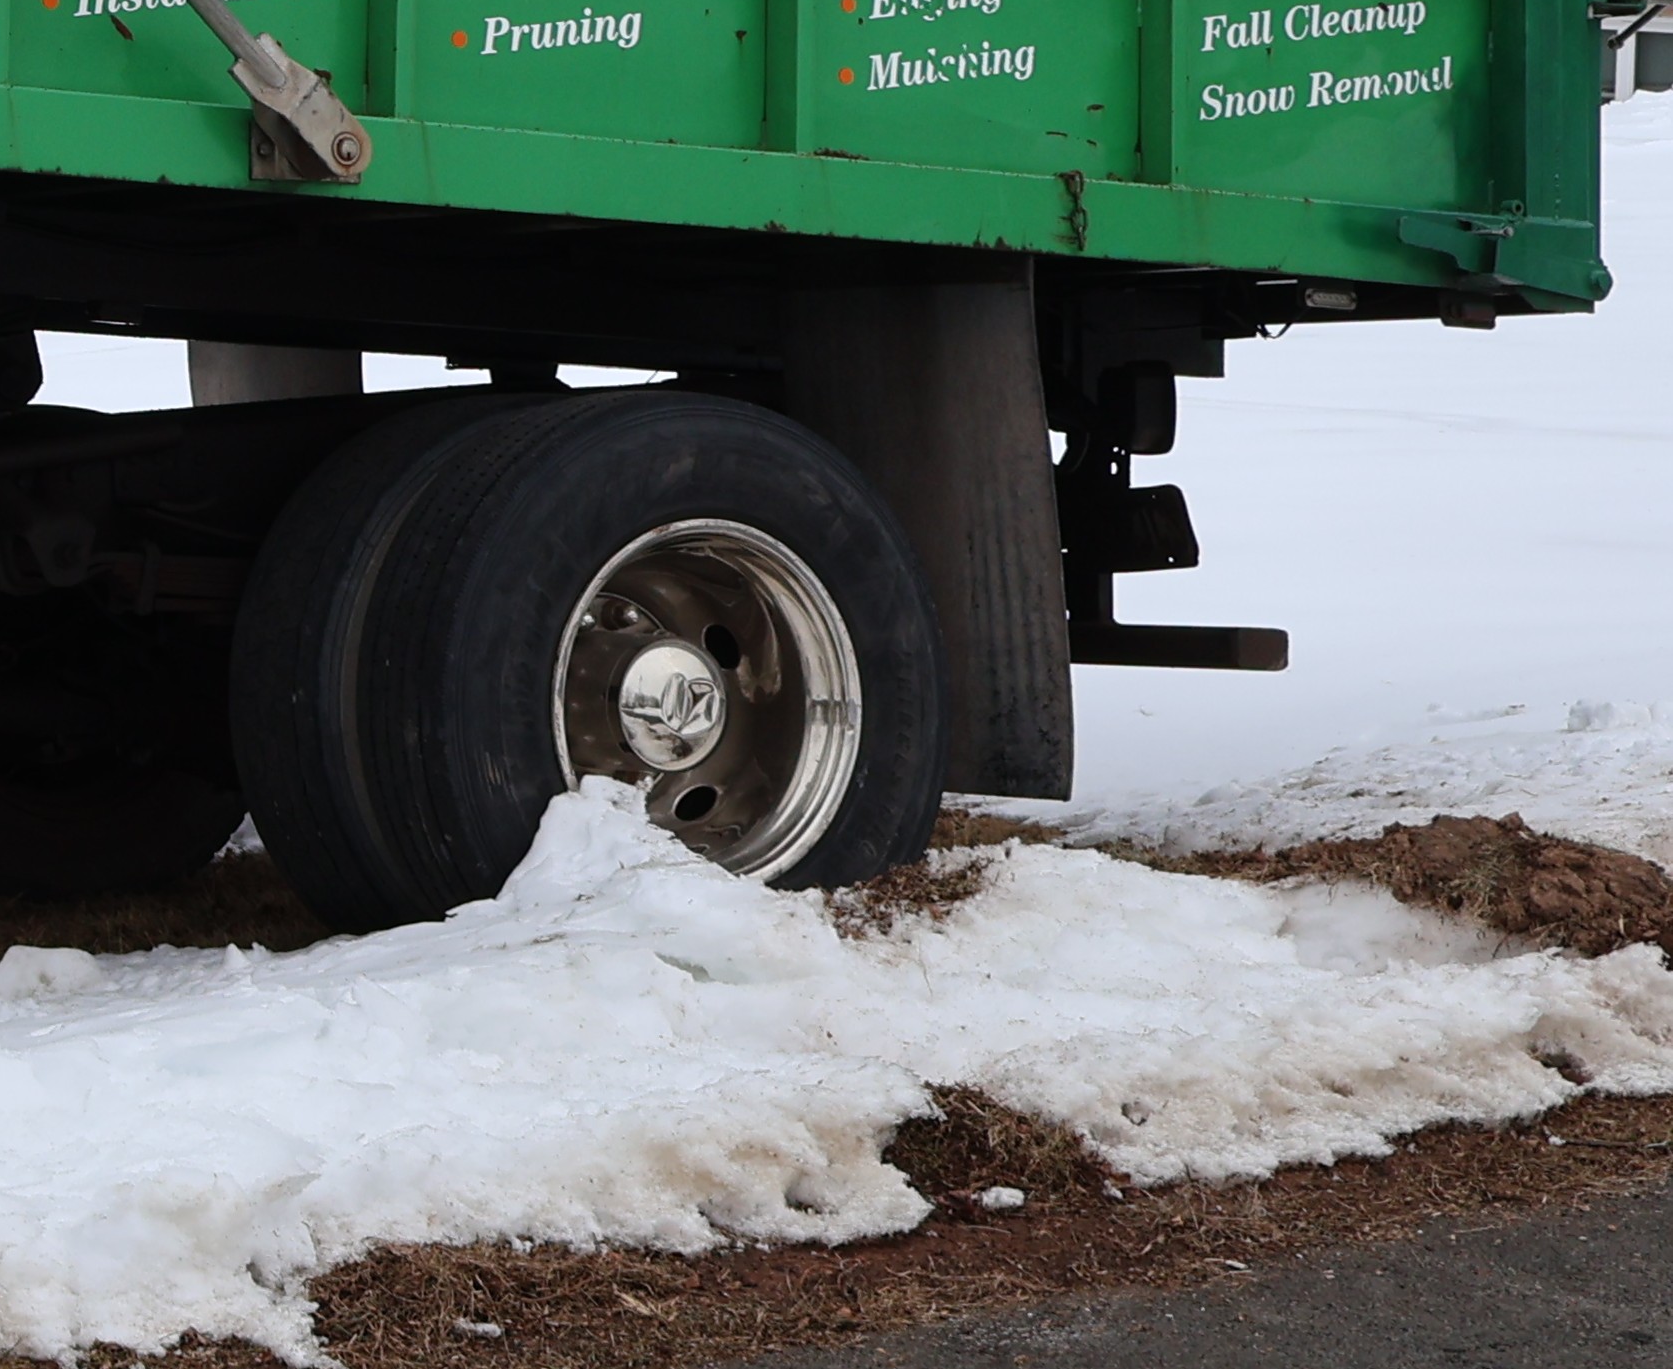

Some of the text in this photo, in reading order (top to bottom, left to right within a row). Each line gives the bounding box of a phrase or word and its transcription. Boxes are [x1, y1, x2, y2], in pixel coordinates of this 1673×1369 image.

[480, 7, 642, 55] Pruning
[1201, 1, 1426, 52] Fall Cleanup
[1200, 56, 1454, 121] Snow Removal
